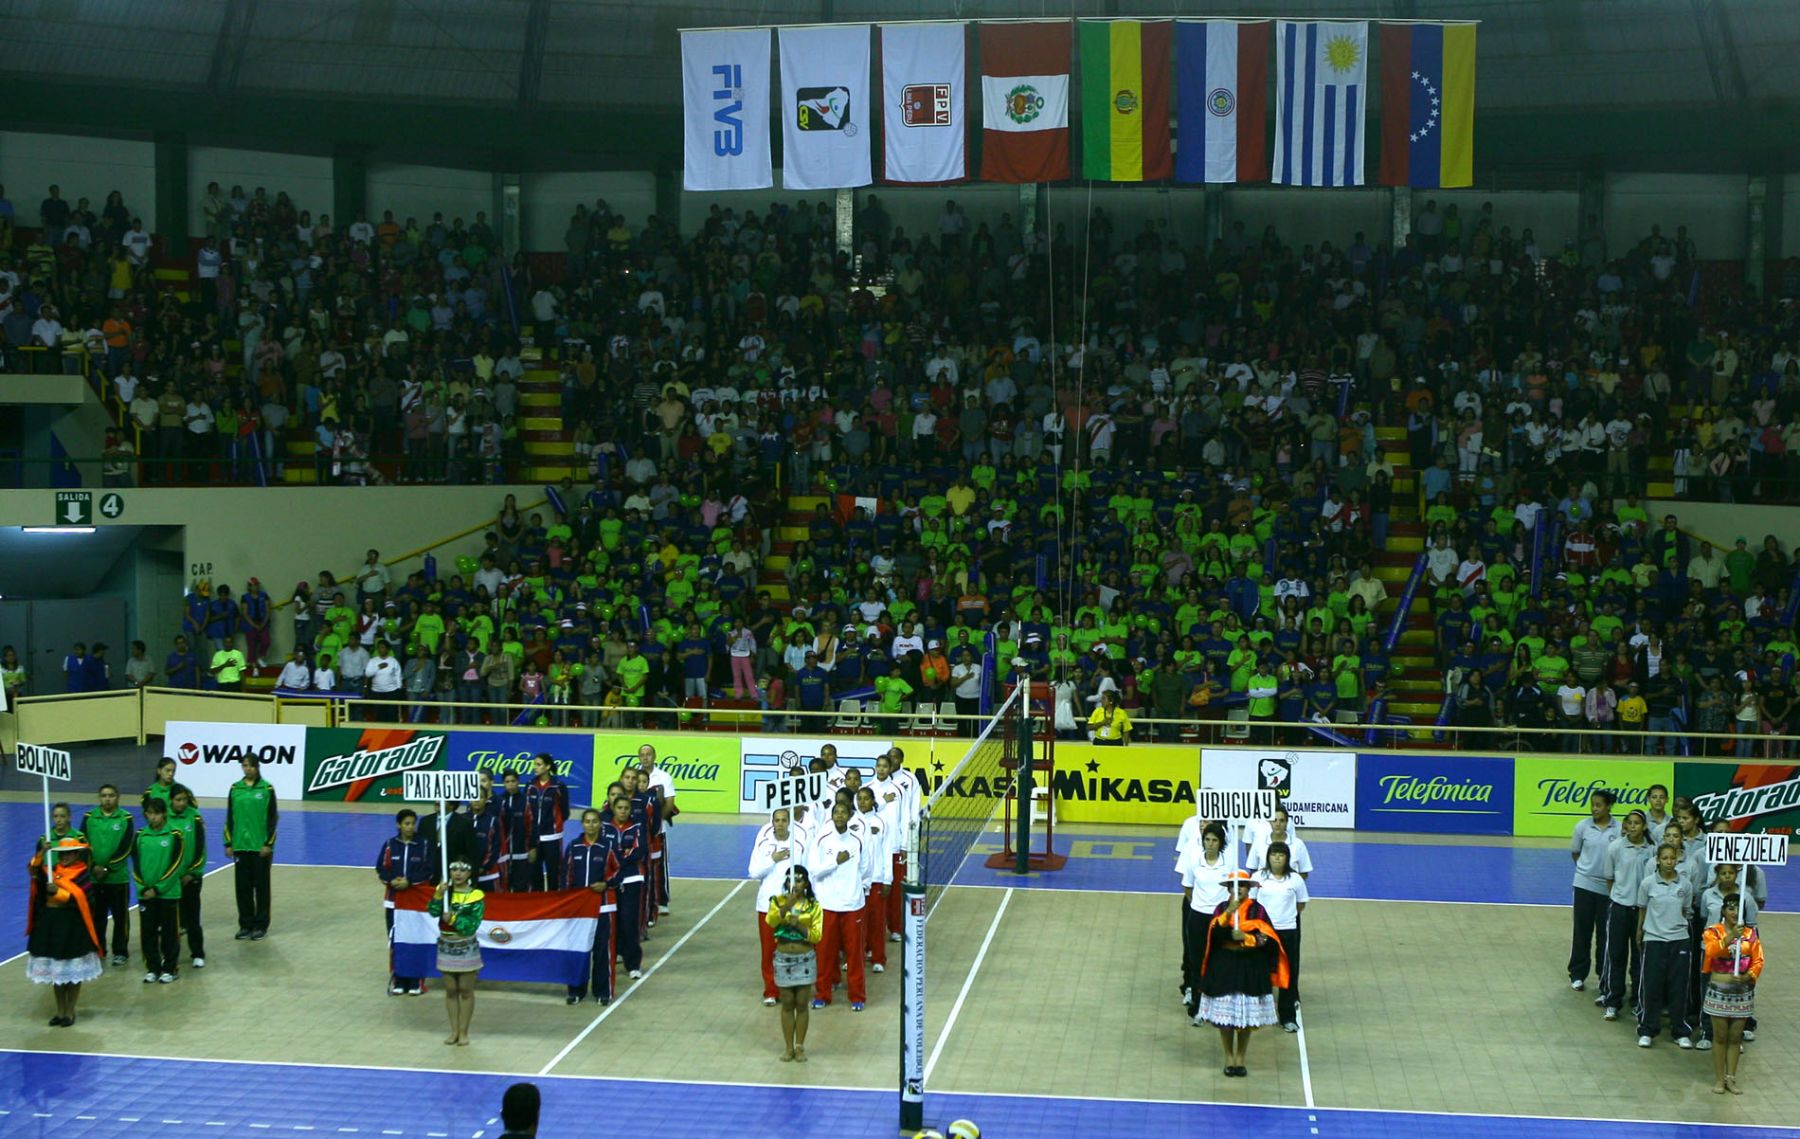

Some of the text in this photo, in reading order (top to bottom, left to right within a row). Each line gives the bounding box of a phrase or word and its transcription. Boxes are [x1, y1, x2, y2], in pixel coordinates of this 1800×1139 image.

[58, 493, 90, 501] SALIDA
[103, 494, 119, 516] 4
[17, 744, 70, 779] BOLIVIA
[312, 738, 440, 789] Gatorade
[405, 772, 479, 800] PARAGUAY
[766, 774, 821, 810] PERU
[1200, 791, 1272, 819] URUGUAY
[1708, 836, 1786, 863] VENEZUELA
